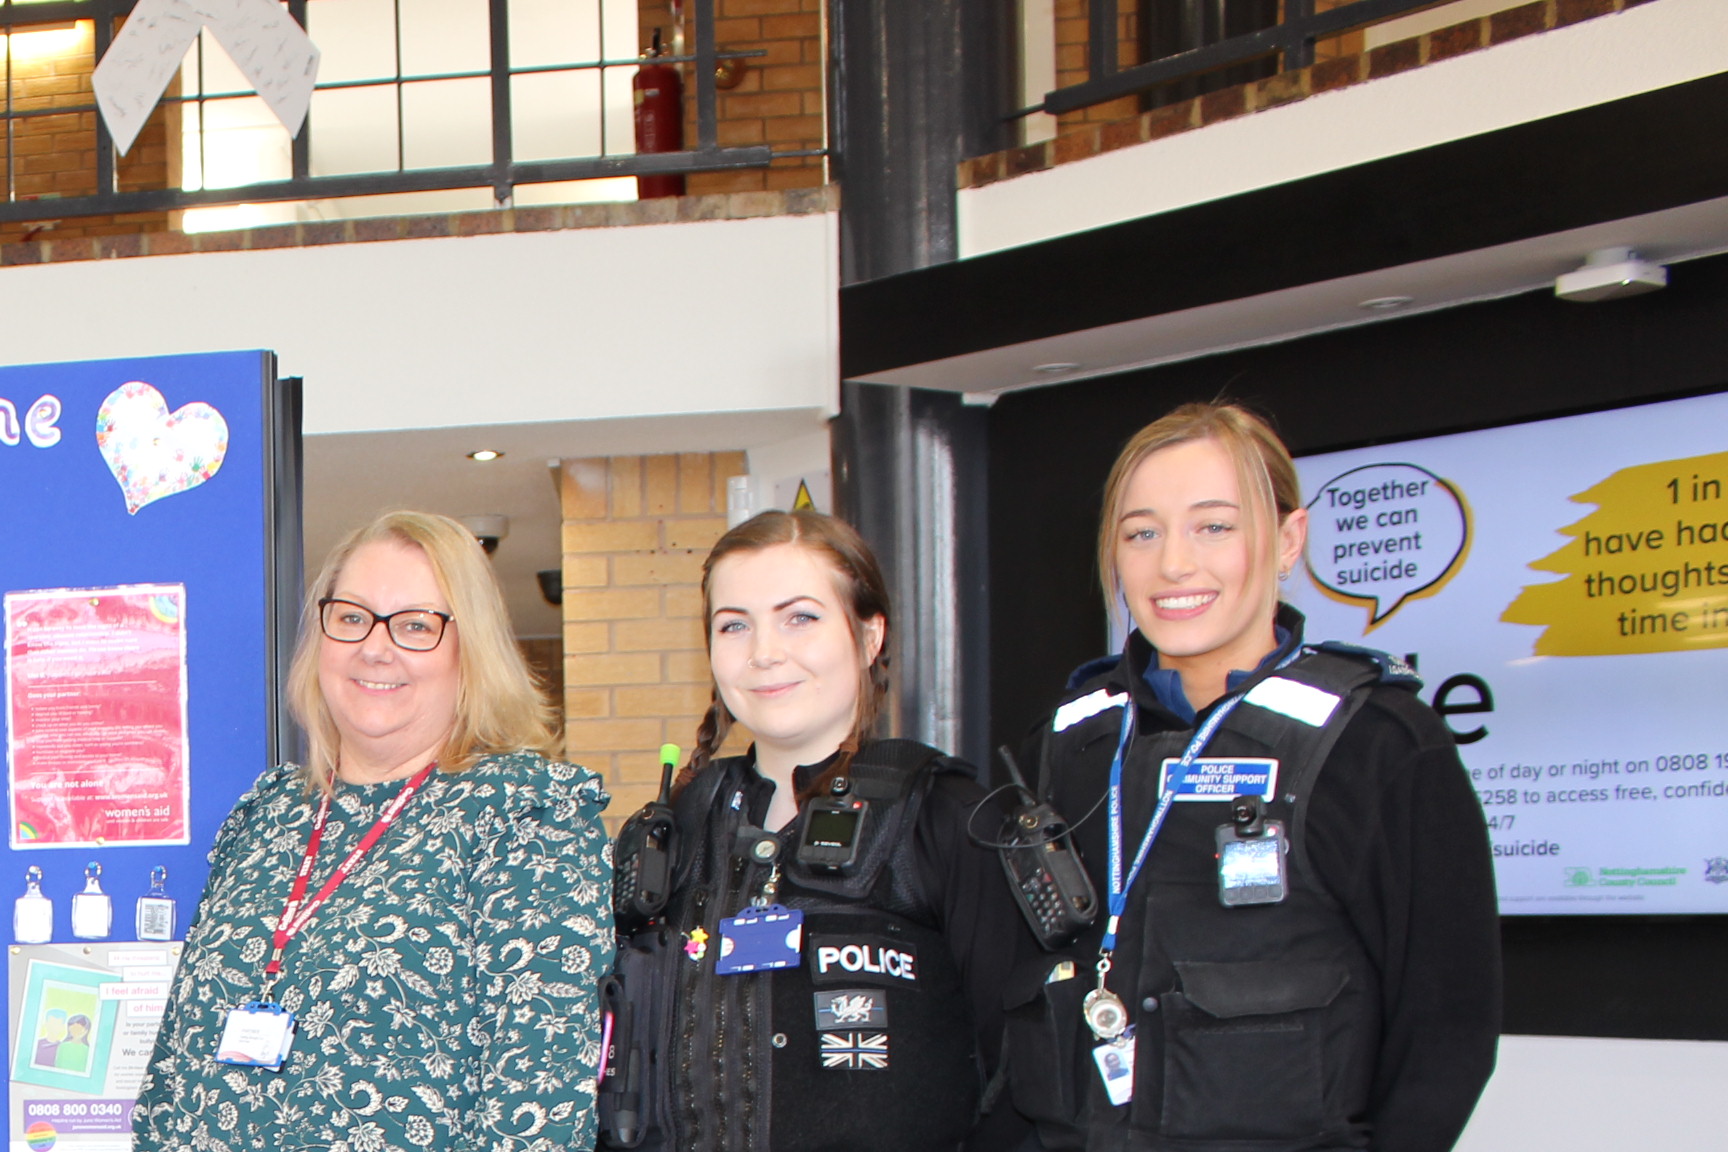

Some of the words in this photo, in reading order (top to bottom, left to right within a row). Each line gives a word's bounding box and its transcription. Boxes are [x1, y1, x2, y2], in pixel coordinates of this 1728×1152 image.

[1327, 478, 1429, 510] Together
[1667, 481, 1678, 504] 1
[1691, 476, 1721, 502] in
[1336, 513, 1369, 532] we
[1375, 507, 1418, 529] can
[1333, 533, 1422, 563] prevent
[1584, 527, 1664, 556] have
[1337, 560, 1418, 586] suicide
[1617, 606, 1688, 636] time
[1201, 764, 1235, 774] POLICE
[1223, 774, 1268, 785] SUPPORT
[1487, 764, 1503, 779] of
[1510, 763, 1542, 782] day
[1548, 765, 1566, 777] or
[1572, 760, 1620, 780] night
[1626, 760, 1649, 773] on
[1656, 755, 1708, 771] 0808
[31, 781, 47, 789] You
[80, 779, 104, 788] alone
[1195, 784, 1235, 793] OFFICER
[1524, 790, 1540, 804] to
[1547, 789, 1608, 803] access
[1615, 784, 1658, 801] free,
[1664, 781, 1728, 799] confid
[105, 806, 151, 818] women's
[154, 805, 170, 816] aid
[1110, 785, 1120, 815] POLICE
[817, 944, 917, 981] POLICE
[111, 986, 128, 995] feel
[131, 986, 159, 995] afraid
[133, 1004, 144, 1012] of
[28, 1103, 60, 1116] 0808
[63, 1103, 87, 1115] 800
[92, 1103, 122, 1115] 0340
